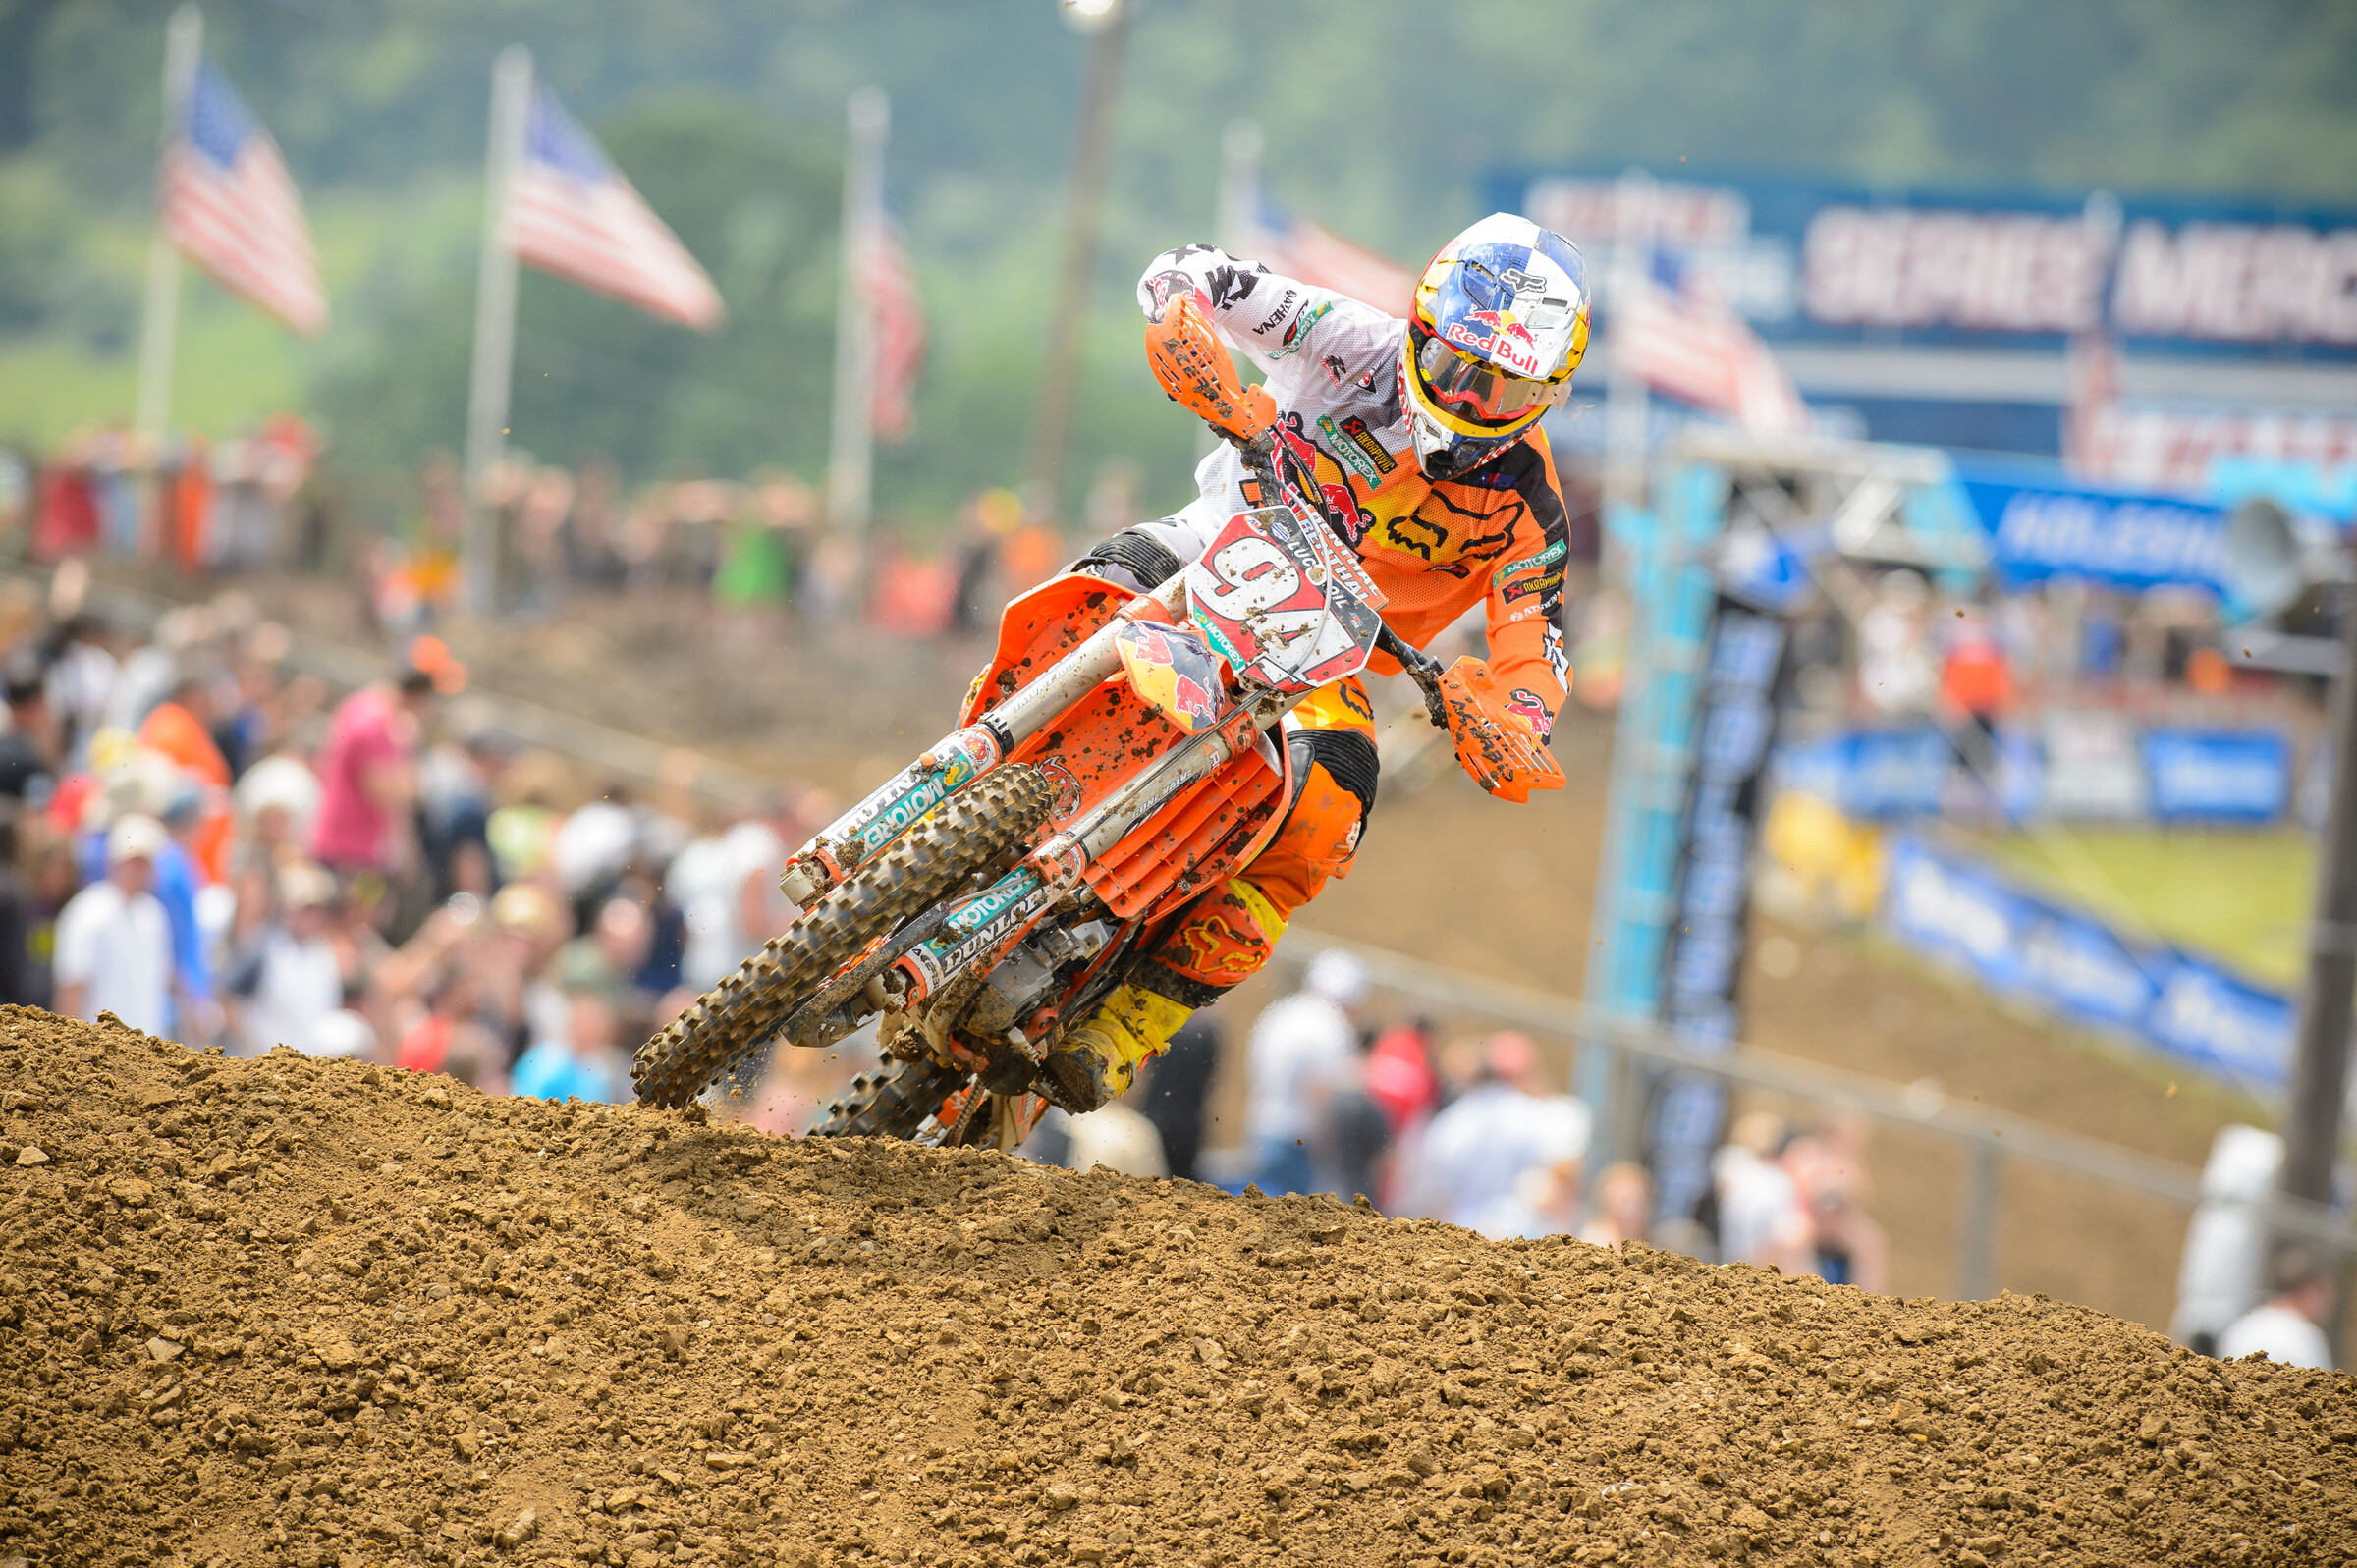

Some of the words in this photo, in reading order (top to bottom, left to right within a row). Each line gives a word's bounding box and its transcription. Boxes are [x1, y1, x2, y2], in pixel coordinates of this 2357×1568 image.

[1447, 323, 1497, 362] Red
[1496, 340, 1539, 375] Bull
[1205, 622, 1244, 667] MOTOREX
